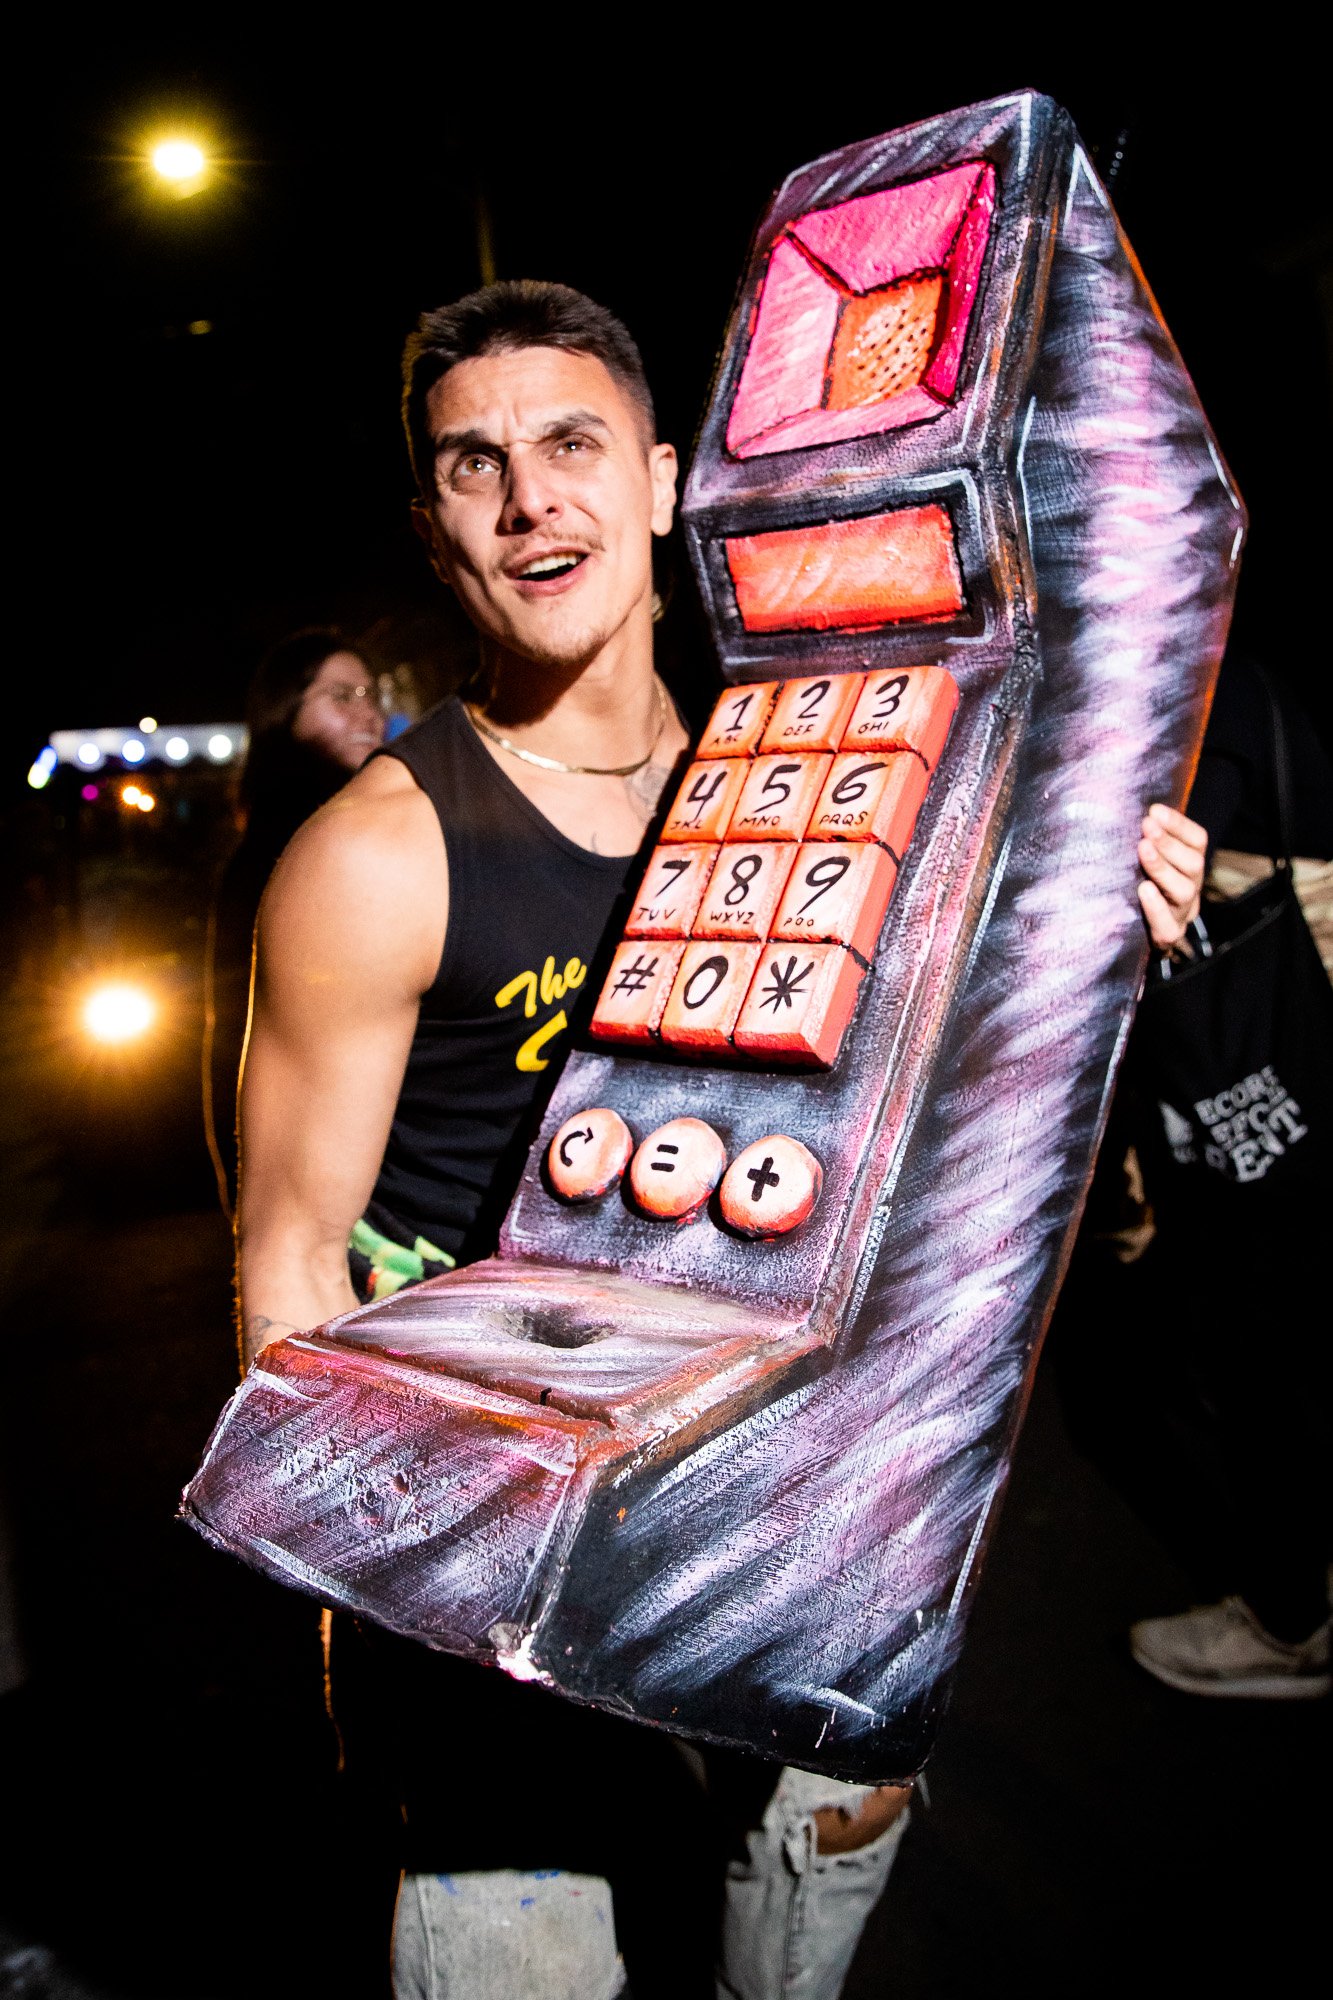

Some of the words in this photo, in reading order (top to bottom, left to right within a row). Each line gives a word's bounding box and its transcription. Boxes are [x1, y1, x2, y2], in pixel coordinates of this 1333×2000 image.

[725, 692, 754, 732] 1
[797, 680, 831, 719] 2
[872, 674, 910, 718] 3
[782, 723, 816, 737] DEF
[687, 771, 728, 822] 4
[752, 763, 802, 813] 5
[831, 762, 889, 805] 6
[738, 815, 781, 827] MNO
[655, 859, 692, 898] 7
[724, 854, 763, 906] 8
[796, 856, 851, 916] 9
[637, 907, 677, 921] TUV
[710, 911, 756, 925] WXYZ
[494, 955, 588, 1019] The
[610, 954, 660, 999] #
[683, 955, 729, 1010] 0
